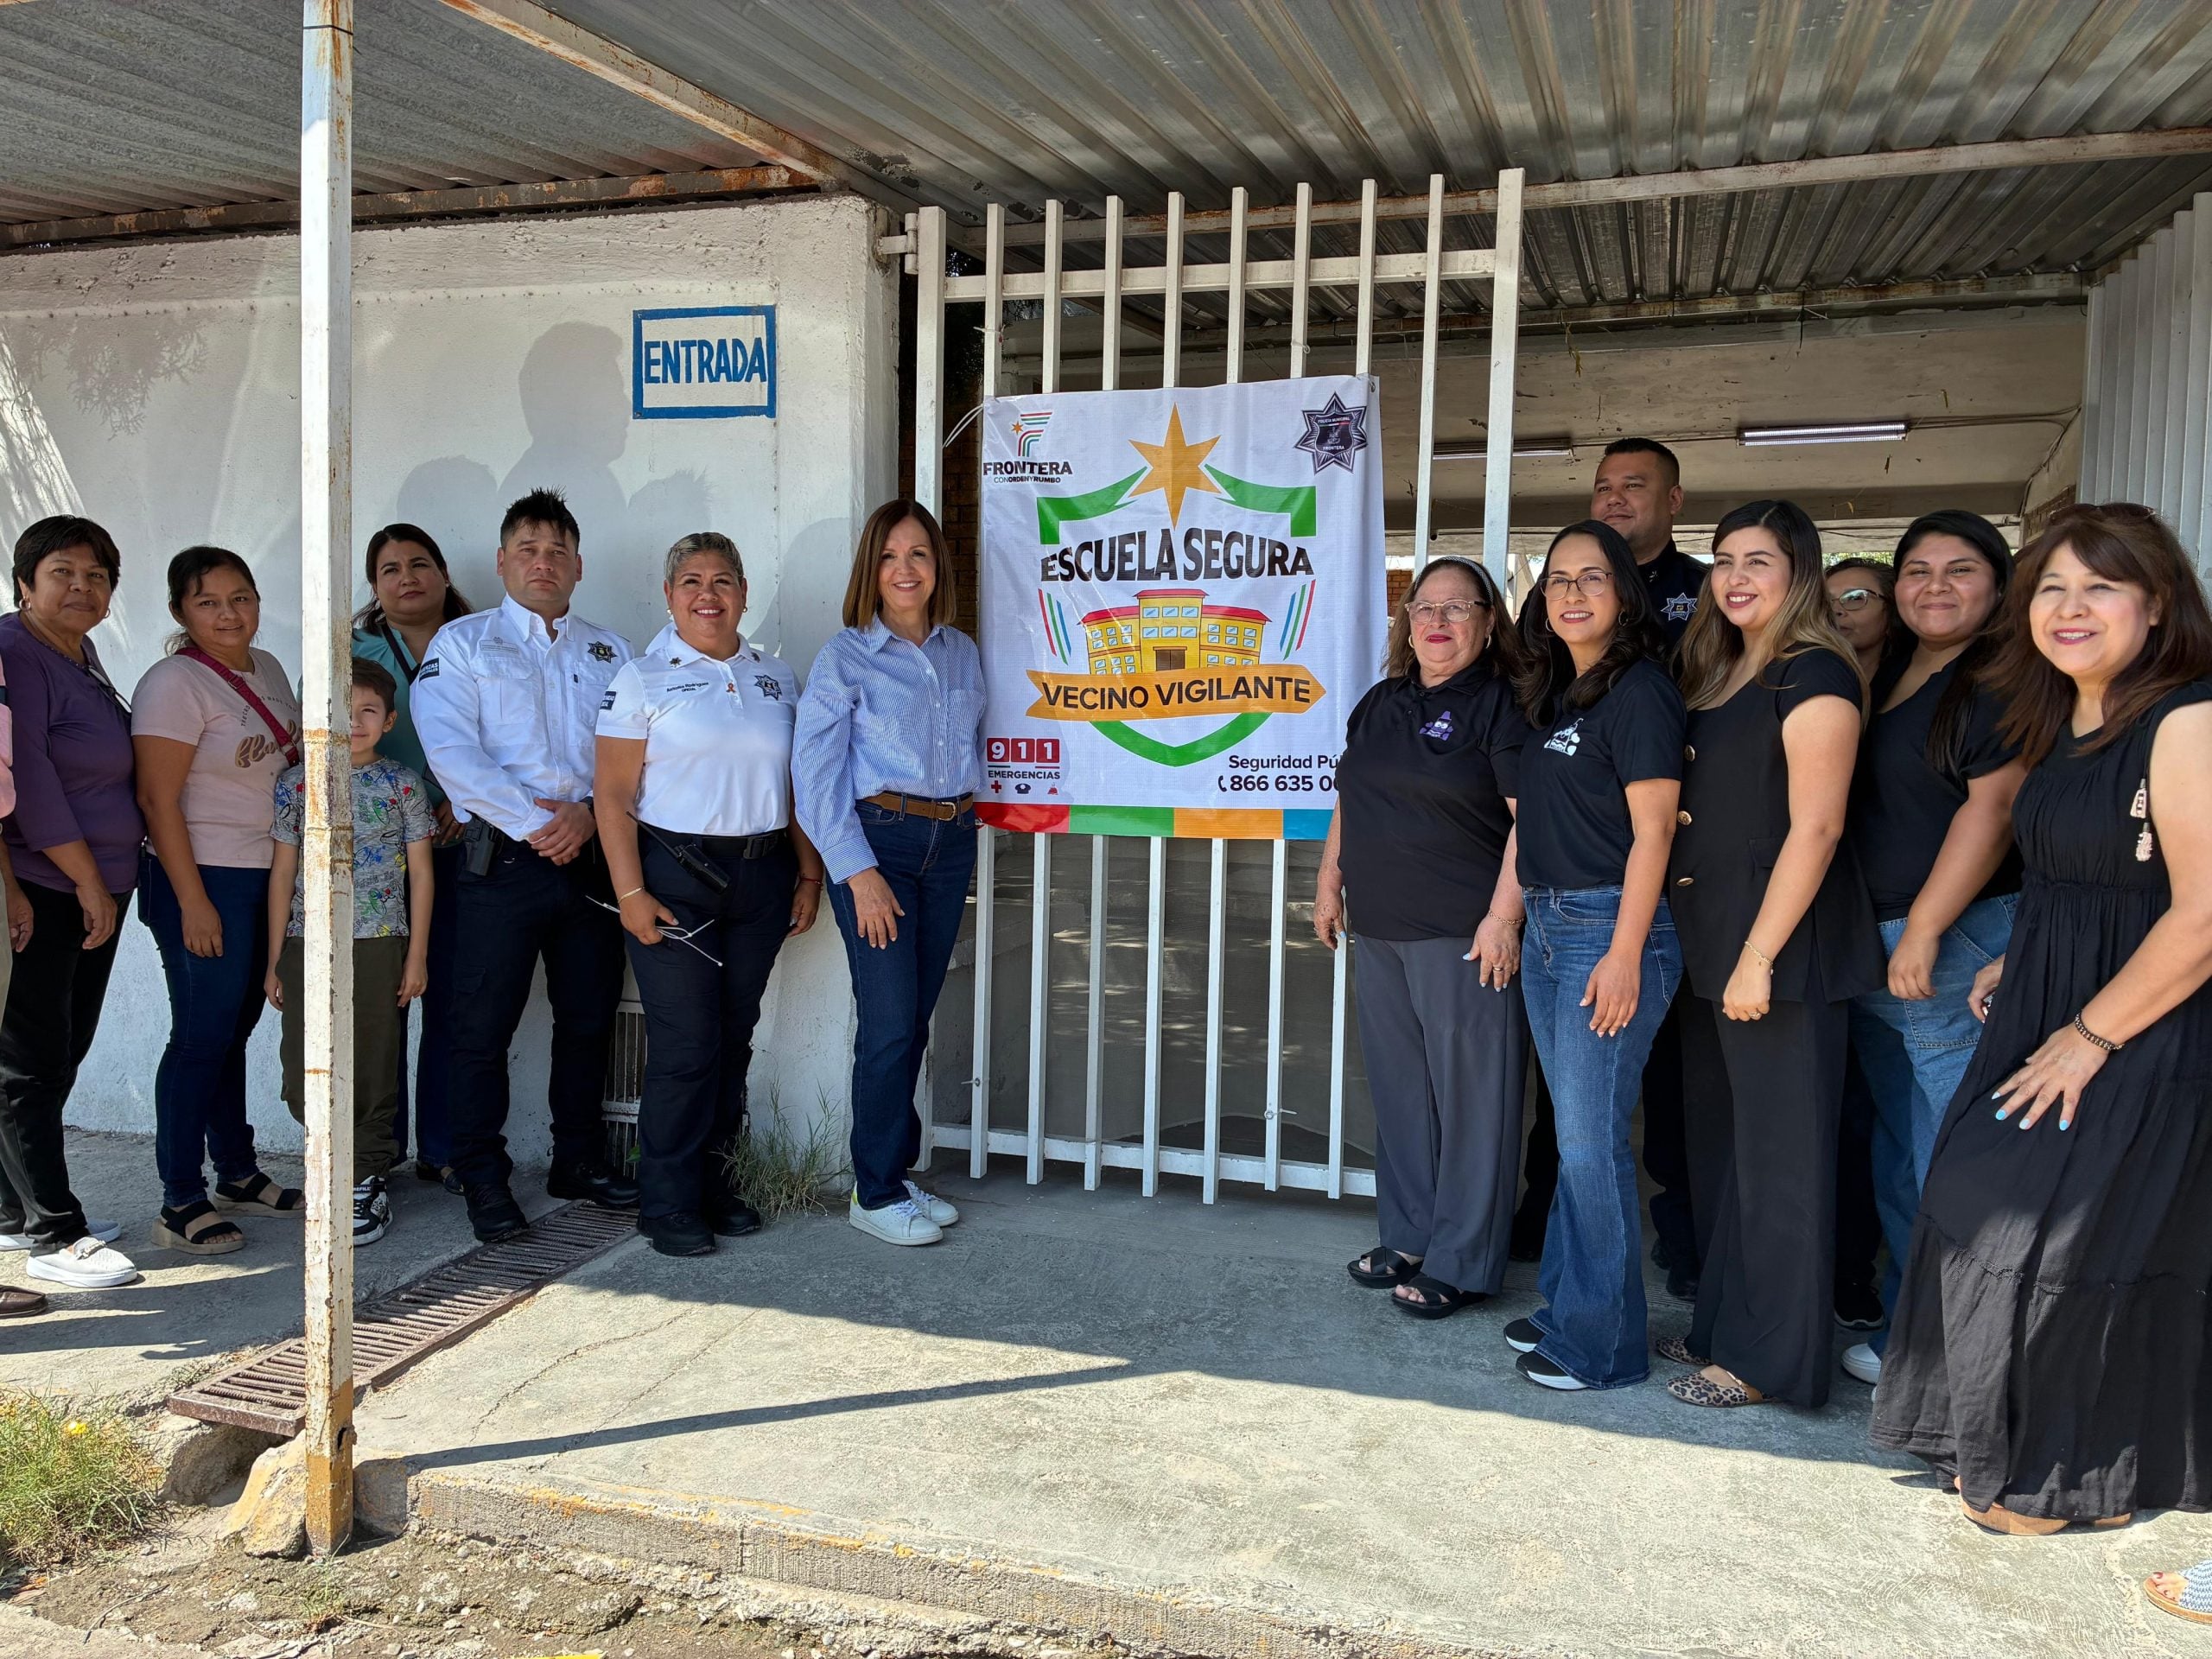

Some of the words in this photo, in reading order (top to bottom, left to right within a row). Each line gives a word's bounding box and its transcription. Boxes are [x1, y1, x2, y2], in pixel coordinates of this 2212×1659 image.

[645, 337, 767, 384] ENTRADA
[982, 461, 1073, 475] FRONTERA
[1040, 528, 1179, 582] ESCUELA
[1183, 527, 1314, 582] SEGURA
[1042, 682, 1149, 710] VECINO
[1154, 676, 1311, 706] VIGILANTE
[991, 741, 1053, 760] 911
[1229, 754, 1313, 772] Seguridad
[1318, 753, 1343, 768] Pú
[988, 771, 1061, 779] EMERGENCIAS
[1230, 775, 1269, 791] 866
[1274, 775, 1313, 791] 635
